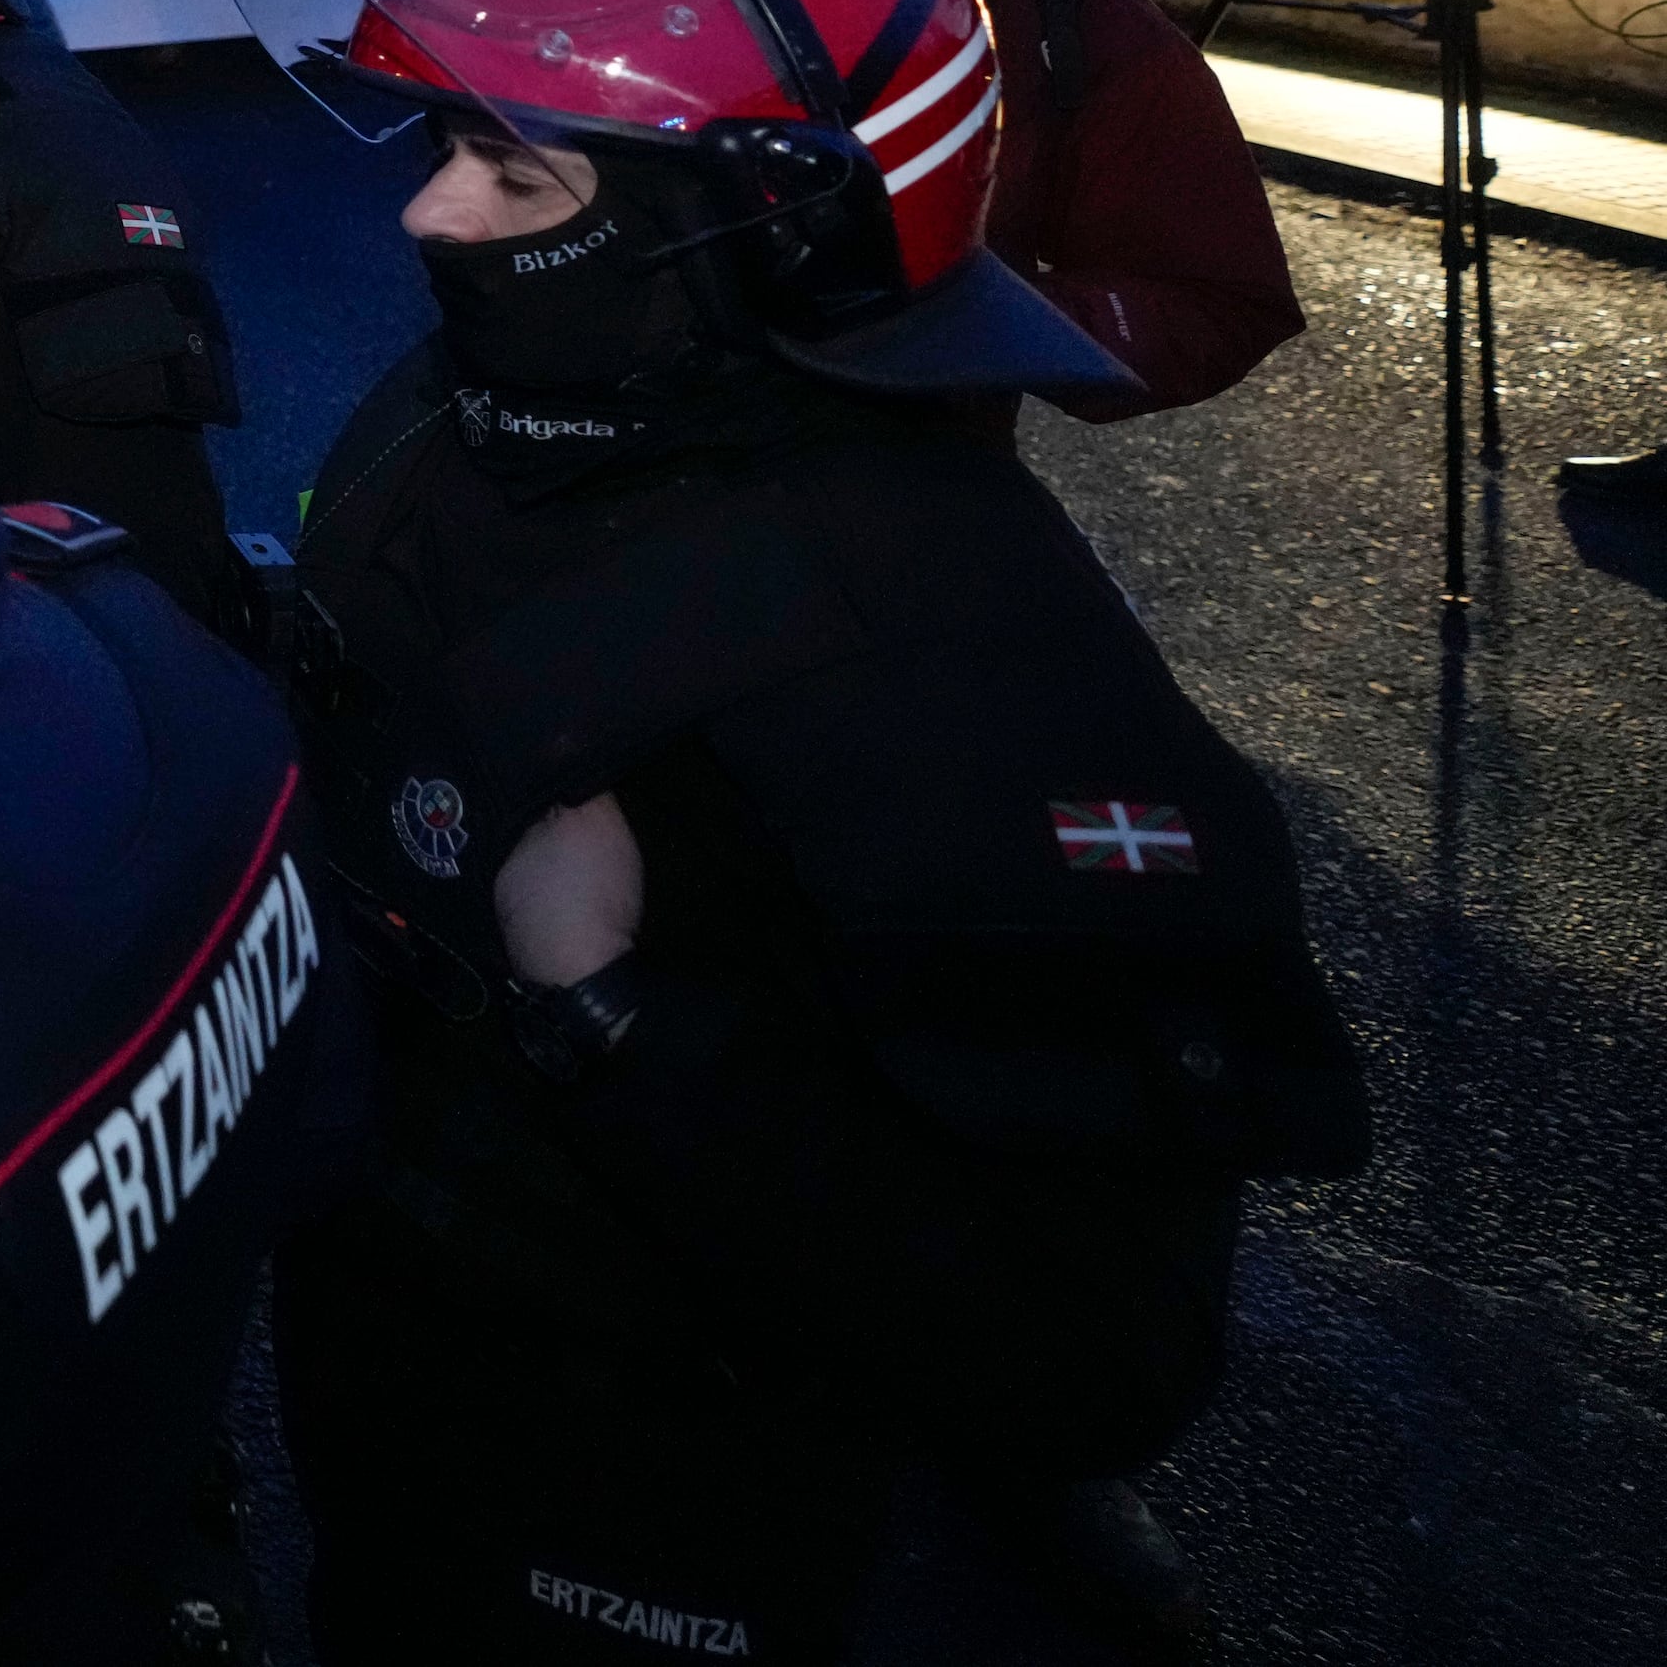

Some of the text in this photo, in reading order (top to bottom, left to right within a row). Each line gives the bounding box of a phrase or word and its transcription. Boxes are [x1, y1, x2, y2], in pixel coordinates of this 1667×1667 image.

[499, 410, 615, 441] Brigada
[58, 851, 321, 1325] ERTZAINTZA
[530, 1568, 750, 1656] ERTZAINTZA
